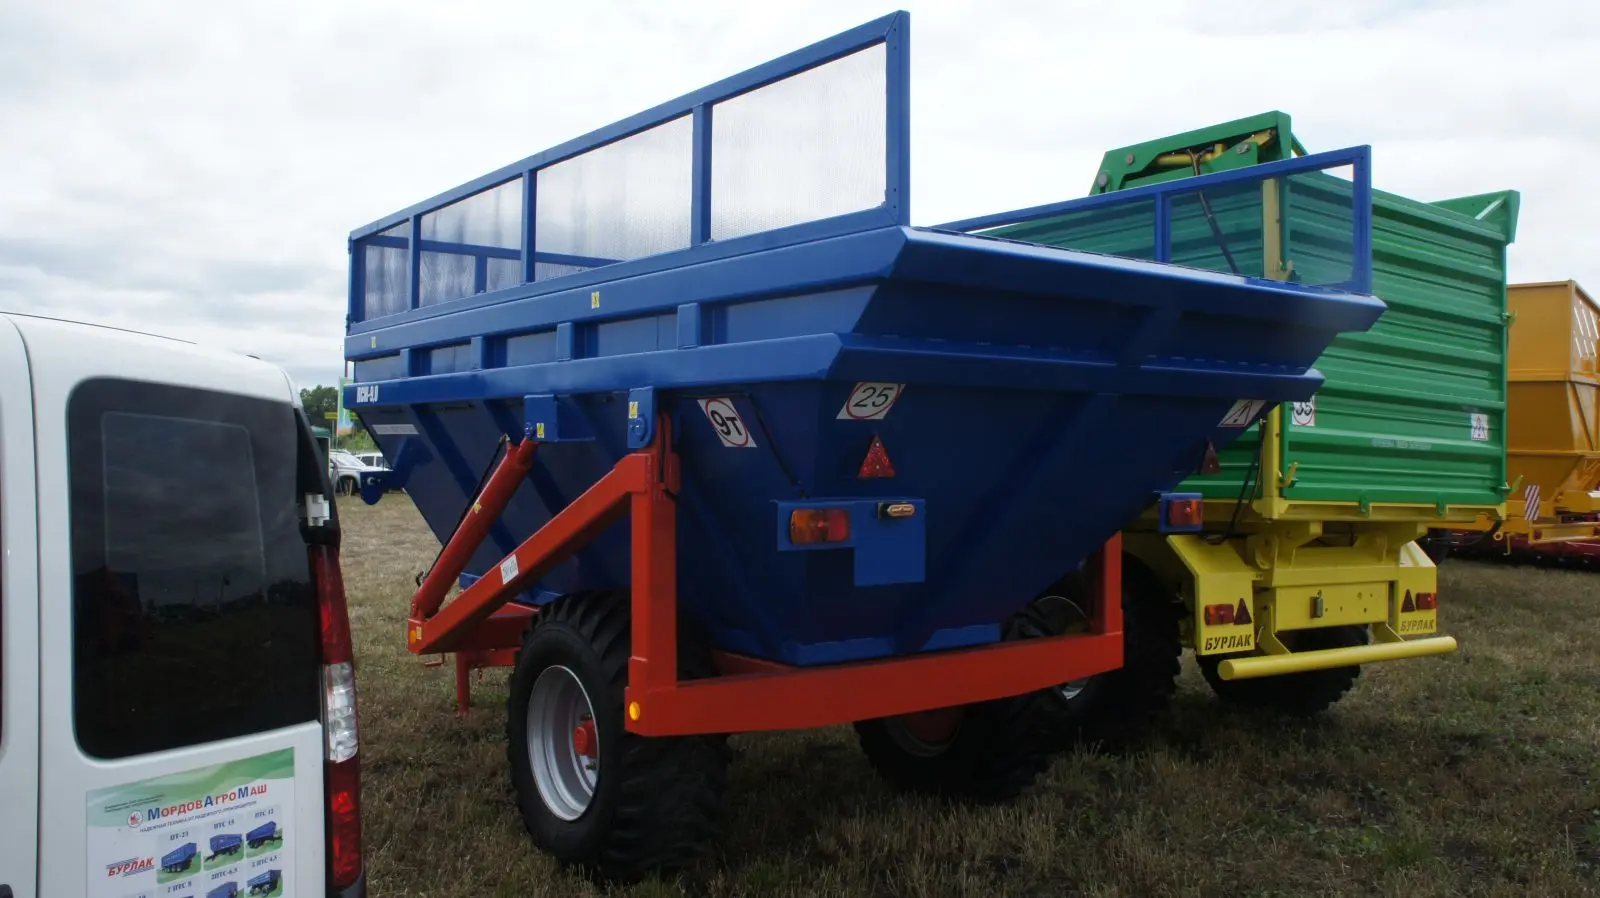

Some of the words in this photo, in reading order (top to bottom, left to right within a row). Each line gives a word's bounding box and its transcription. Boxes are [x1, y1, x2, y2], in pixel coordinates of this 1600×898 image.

[853, 386, 894, 408] 25
[1399, 618, 1434, 633] БУРЛАК
[1204, 633, 1252, 651] БУРЛАК
[107, 857, 154, 877] БУРЛАК
